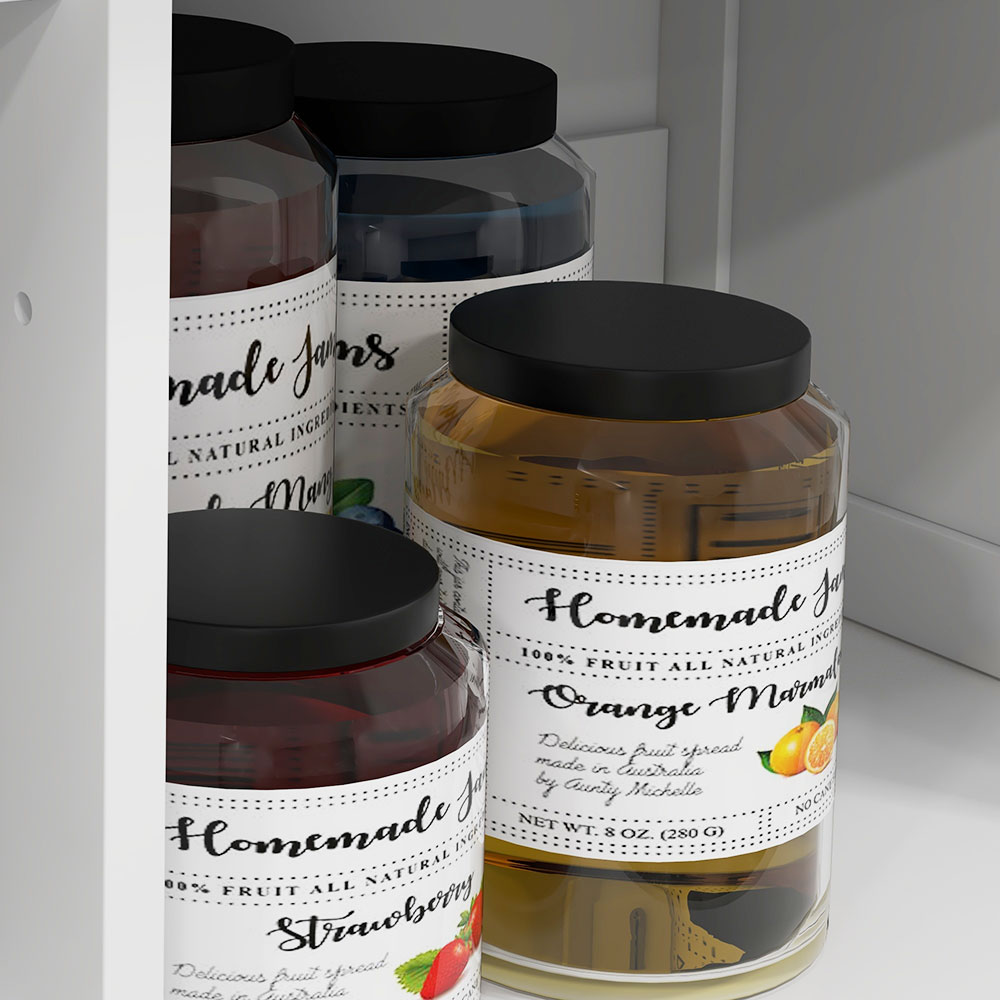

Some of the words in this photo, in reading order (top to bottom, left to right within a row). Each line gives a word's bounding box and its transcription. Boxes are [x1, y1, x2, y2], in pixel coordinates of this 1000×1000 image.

[334, 401, 407, 416] IENTS
[188, 432, 284, 463] NATURAL
[524, 583, 807, 634] Homemade
[521, 647, 575, 666] 100%
[586, 657, 661, 672] FRUIT
[668, 660, 713, 672] ALL
[721, 642, 806, 670] NATURAL
[527, 684, 702, 730] Orange
[534, 756, 587, 772] made
[591, 764, 611, 775] in
[616, 763, 705, 777] Australia
[538, 732, 628, 756] Delicious
[627, 742, 678, 765] fruit
[680, 736, 744, 769] spread
[535, 770, 559, 798] by
[563, 777, 622, 807] Aunty
[624, 780, 704, 797] Michelle
[795, 798, 812, 815] NO
[165, 795, 452, 858] Homemade
[518, 811, 560, 830] NET
[562, 821, 600, 837] WT.
[604, 826, 616, 838] 8
[620, 828, 655, 840] OZ.
[660, 828, 699, 841] (280
[702, 826, 725, 839] G)
[221, 885, 300, 897] FRUIT
[309, 881, 356, 895] ALL
[365, 849, 451, 886] NATURAL
[266, 872, 475, 951] Strawberry
[170, 962, 267, 983] Delicious
[268, 967, 322, 991] fruit
[324, 952, 390, 991] spread
